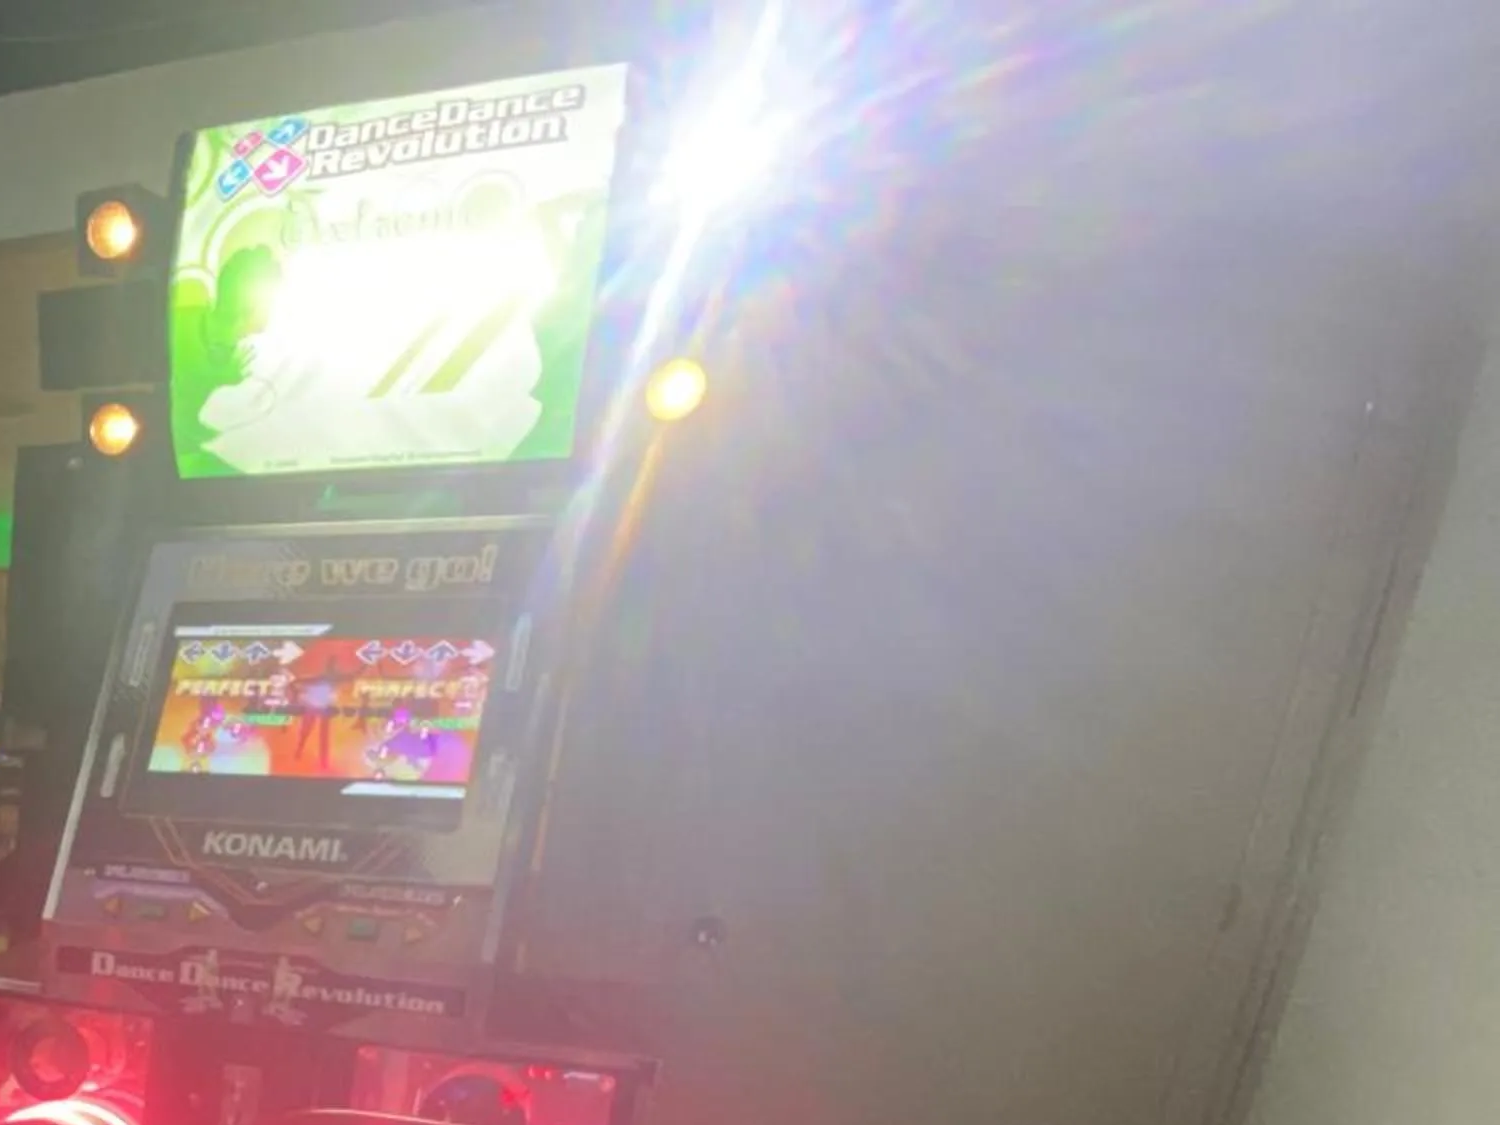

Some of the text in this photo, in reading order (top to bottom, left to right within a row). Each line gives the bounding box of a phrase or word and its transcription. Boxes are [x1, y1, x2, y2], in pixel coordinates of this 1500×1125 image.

[306, 84, 586, 151] DanceDance
[306, 116, 568, 180] Revolution
[174, 677, 267, 698] PERFECT
[202, 830, 344, 863] KONAMI
[90, 950, 175, 983] Dance
[275, 968, 446, 1015] Revolution
